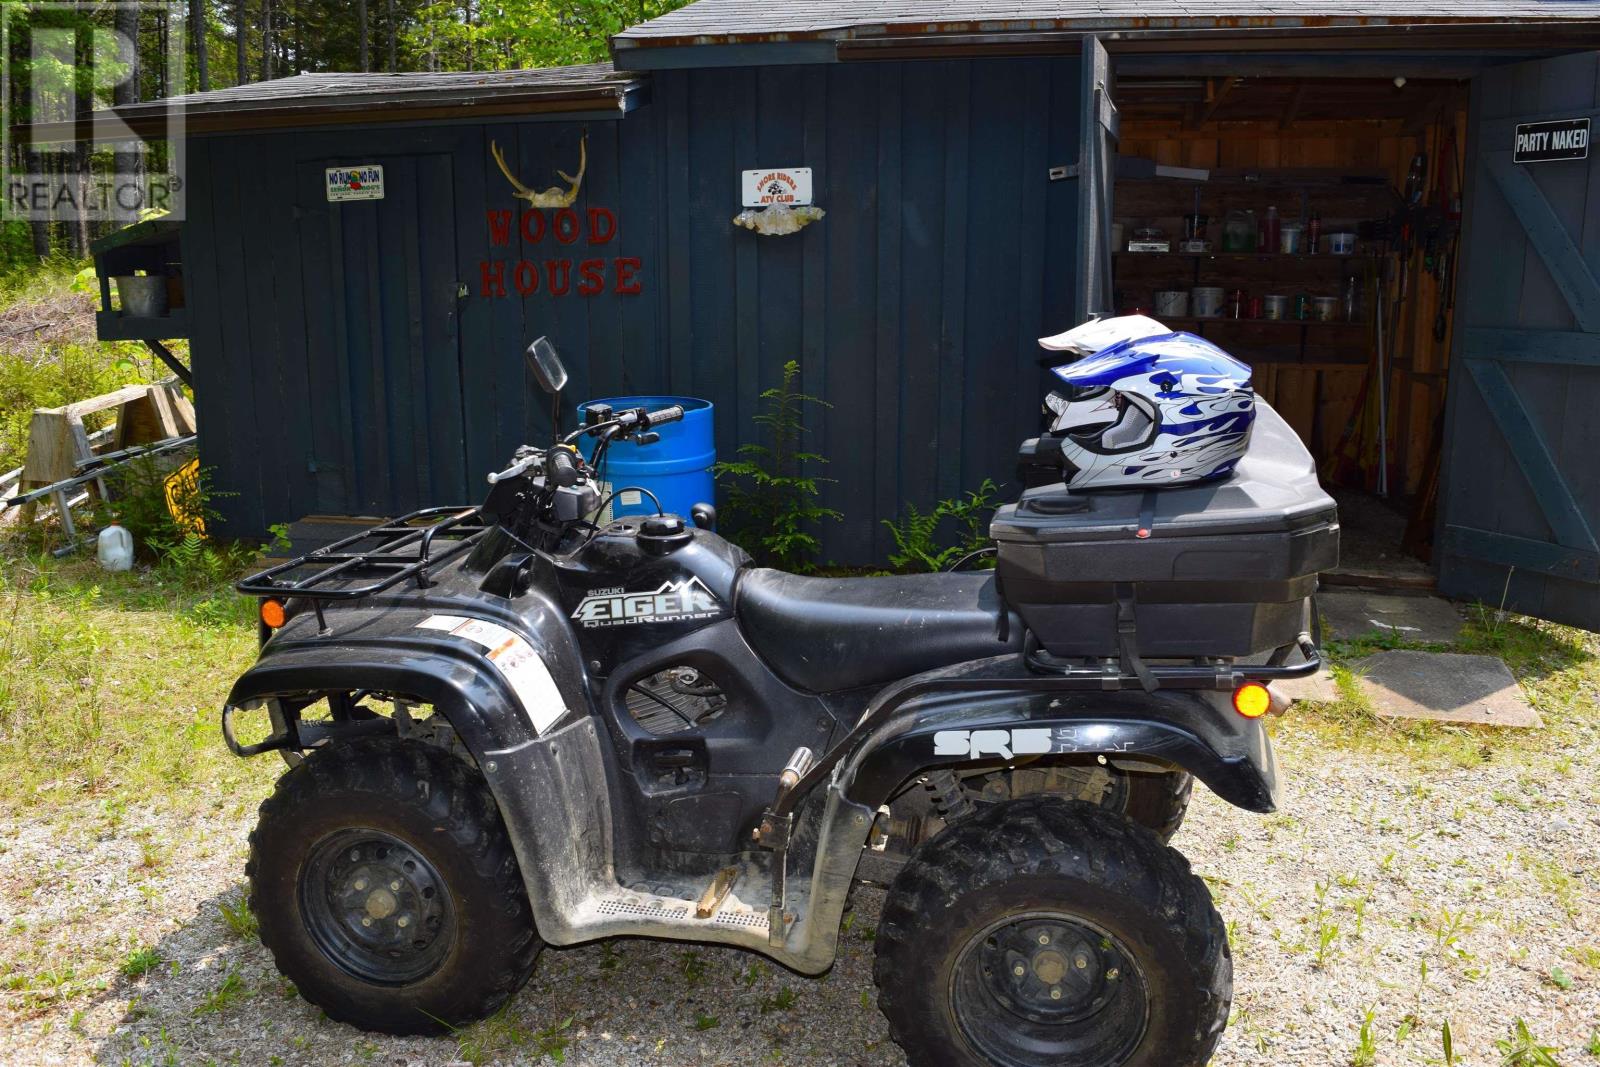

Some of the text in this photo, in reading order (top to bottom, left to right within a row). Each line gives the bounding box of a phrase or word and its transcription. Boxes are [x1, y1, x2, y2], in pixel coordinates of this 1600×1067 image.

[1516, 129, 1587, 152] PARTY NAKED
[329, 172, 338, 185] NO
[368, 169, 380, 182] FUN
[776, 194, 794, 203] CLUB
[486, 207, 617, 247] WOOD
[480, 256, 642, 298] HOUSE
[587, 587, 625, 597] SUZUKI
[580, 592, 720, 621] EIGER
